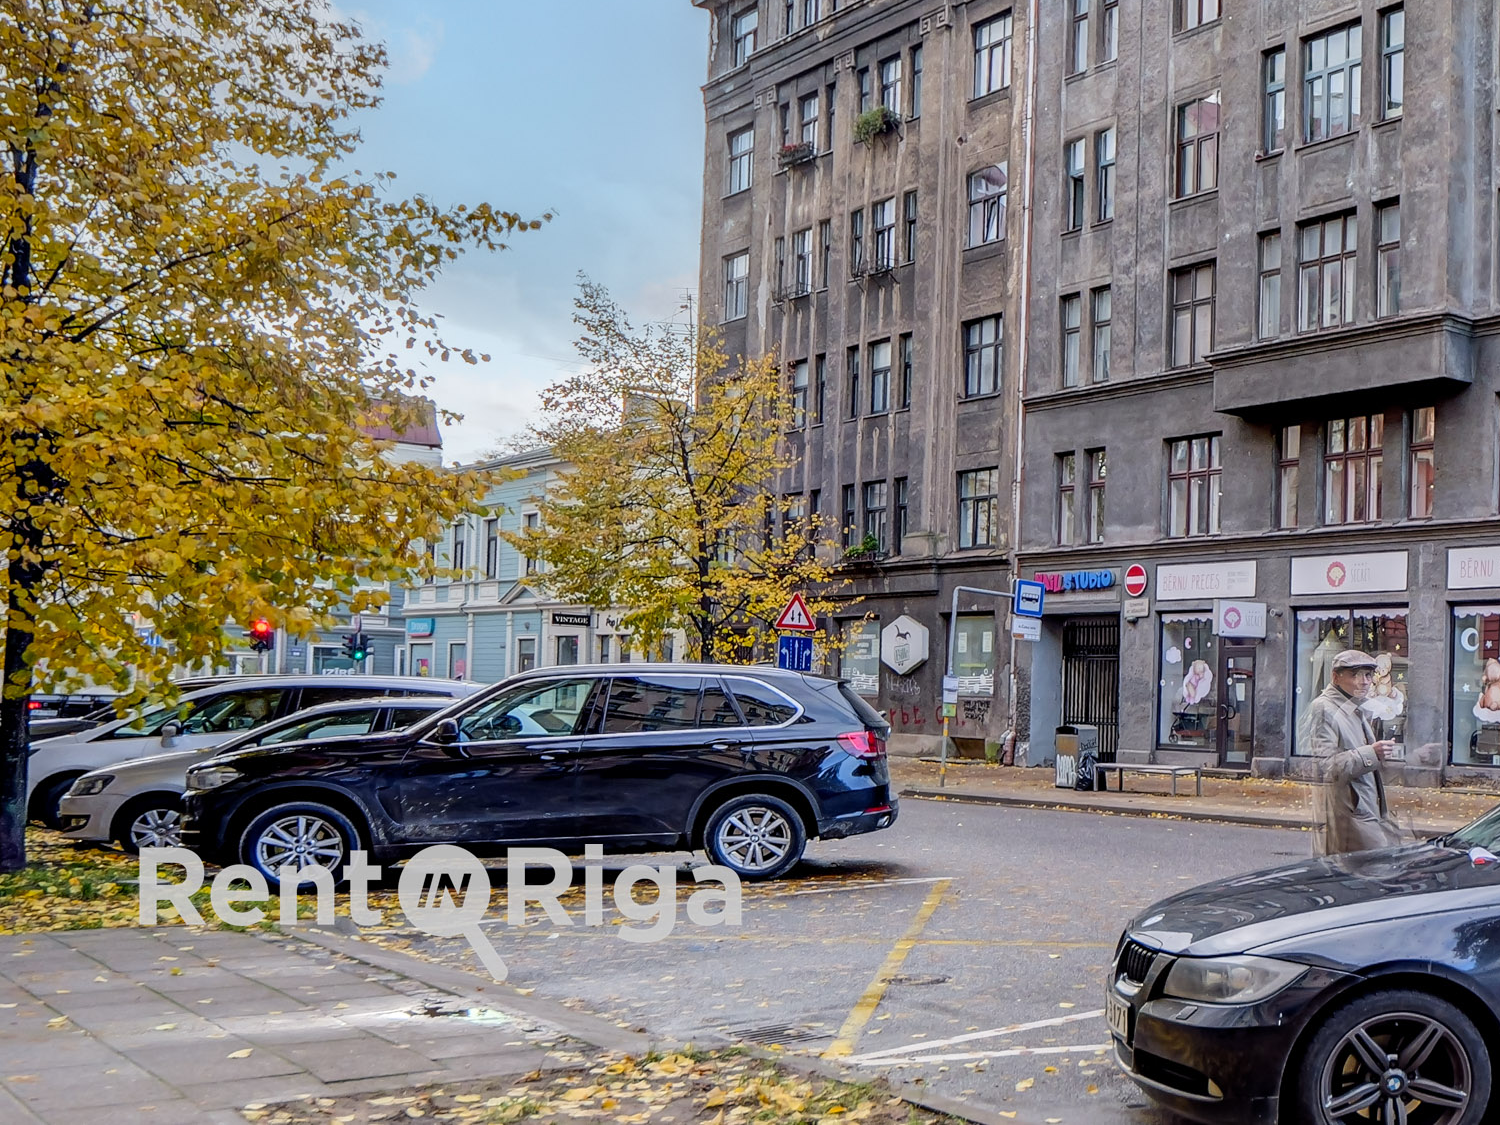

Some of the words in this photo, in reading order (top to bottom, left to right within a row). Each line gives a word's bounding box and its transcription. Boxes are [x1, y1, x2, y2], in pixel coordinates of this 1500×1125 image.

[1459, 557, 1494, 579] BĒRNU
[1162, 574, 1188, 592] BĒRNU
[1191, 574, 1220, 590] PRECES
[555, 615, 589, 624] VINTAGE
